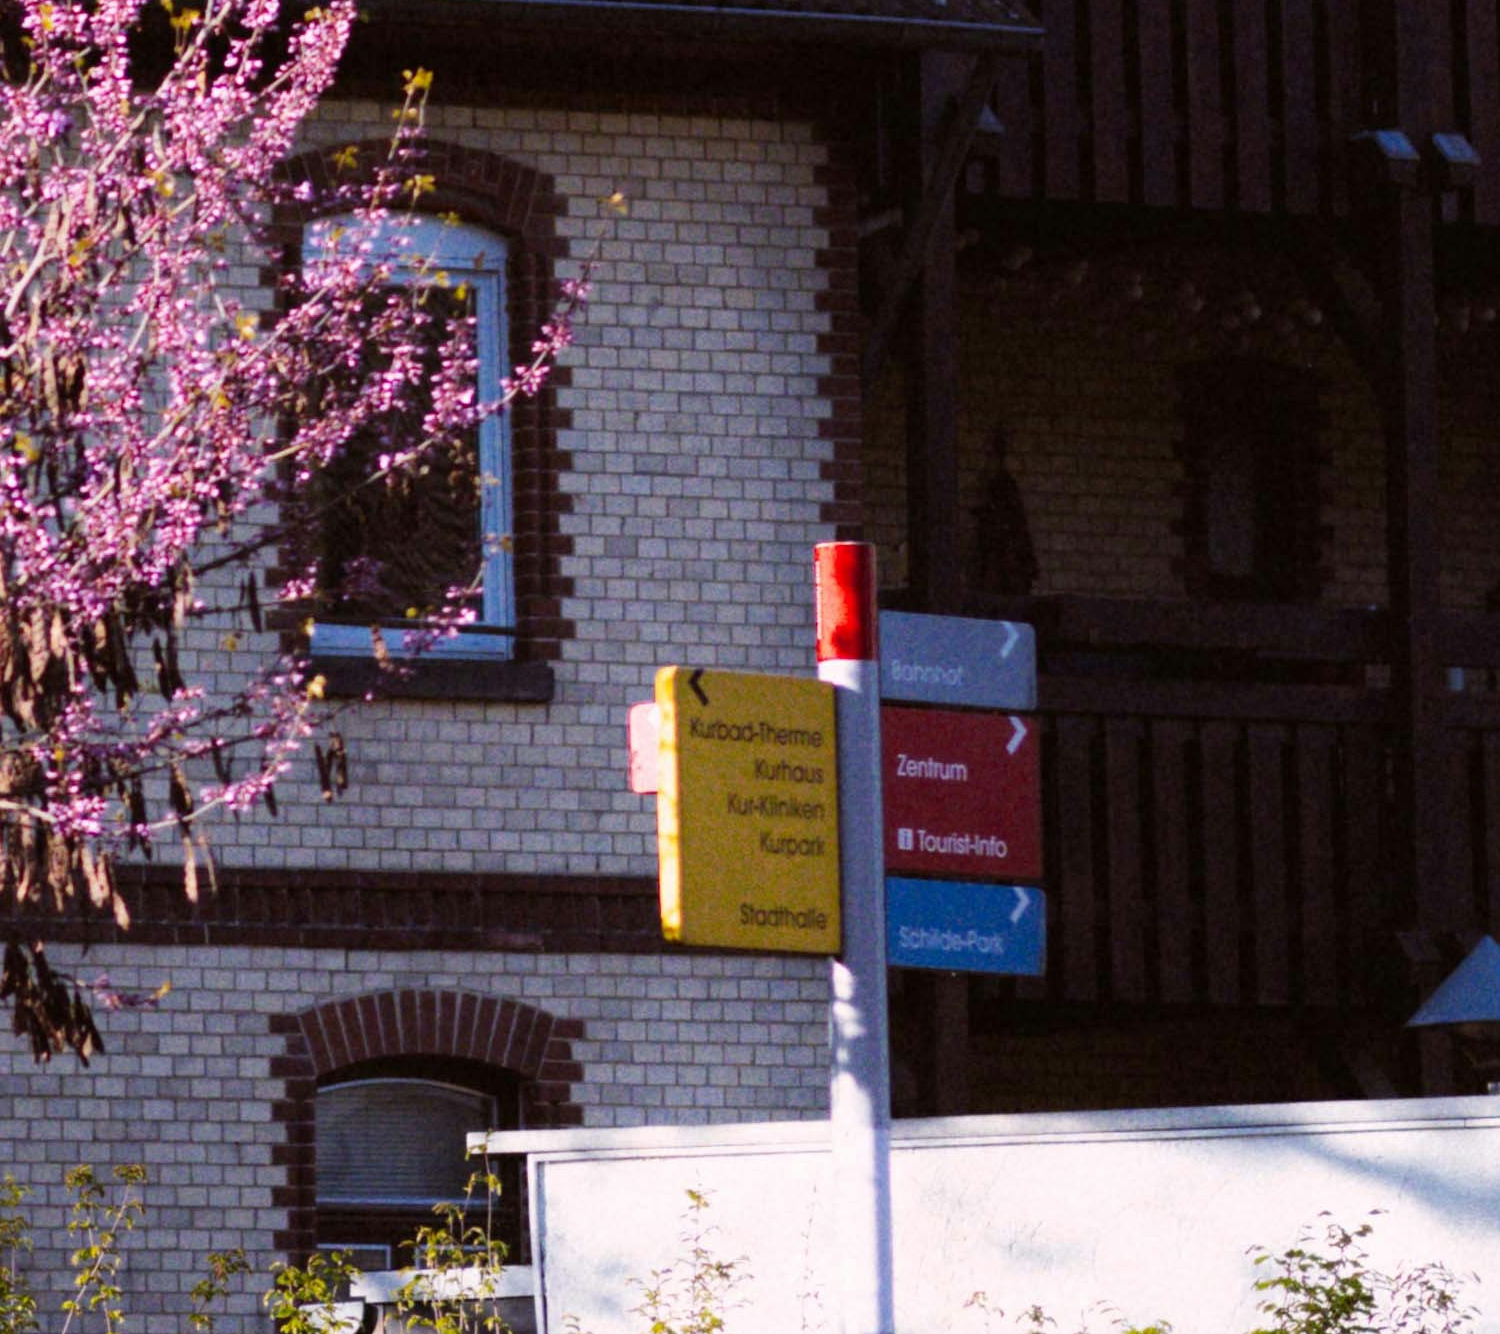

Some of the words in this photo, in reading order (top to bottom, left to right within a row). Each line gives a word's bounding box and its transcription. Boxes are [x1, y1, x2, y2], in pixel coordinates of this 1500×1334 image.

[690, 718, 823, 747] Kurbad-Therme
[755, 758, 825, 784] Kurhaus
[896, 754, 968, 781] Zentrum
[727, 792, 825, 821] Kur-Kliniken
[760, 831, 826, 858] Kurpark
[917, 829, 1008, 858] Tourist-Info
[739, 903, 828, 930] Stadthalle
[899, 925, 1005, 954] Schilde-Park
